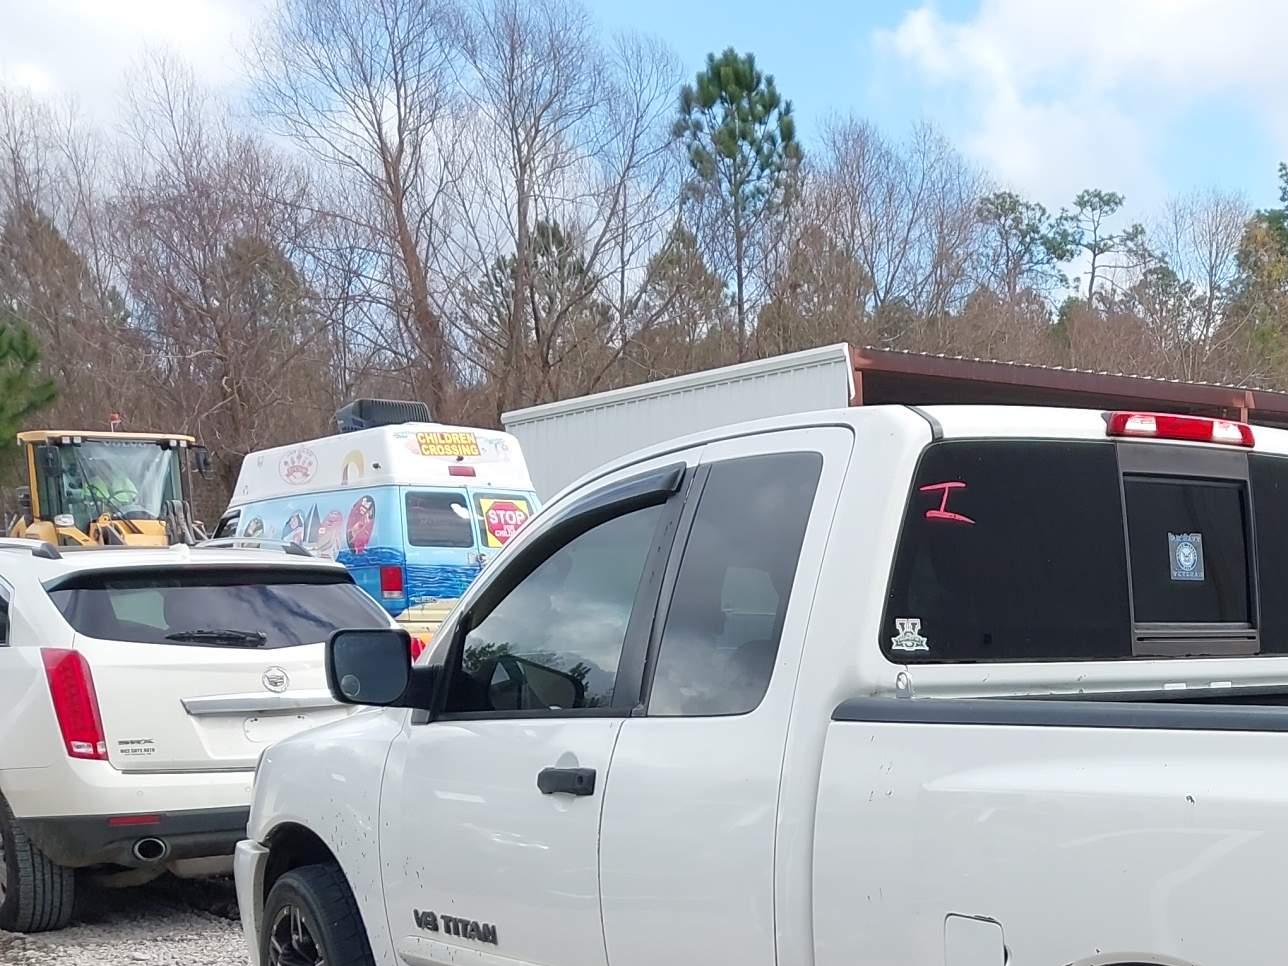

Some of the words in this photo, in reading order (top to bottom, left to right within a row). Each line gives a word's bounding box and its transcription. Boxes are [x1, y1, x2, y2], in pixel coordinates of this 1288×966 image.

[416, 432, 477, 445] CHILDREN
[420, 444, 480, 456] CROSSING
[488, 509, 528, 525] STOP
[413, 908, 439, 932] V8
[440, 914, 498, 946] TITAN
